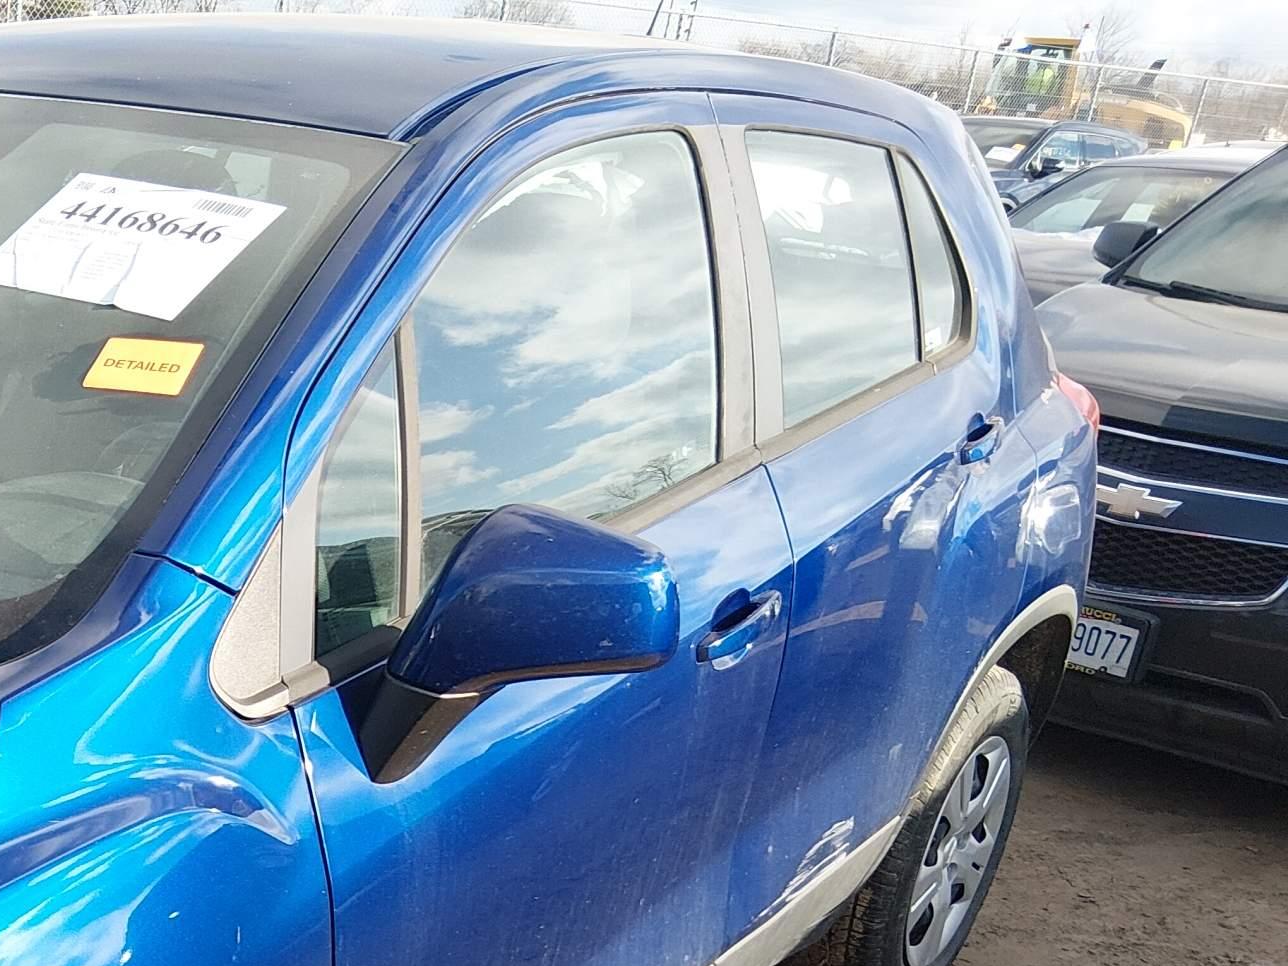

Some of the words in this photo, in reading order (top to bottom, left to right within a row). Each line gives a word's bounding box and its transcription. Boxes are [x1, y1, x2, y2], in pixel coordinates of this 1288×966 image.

[60, 201, 224, 244] 44168646
[103, 358, 181, 374] DETAILED
[1072, 623, 1132, 664] 9077
